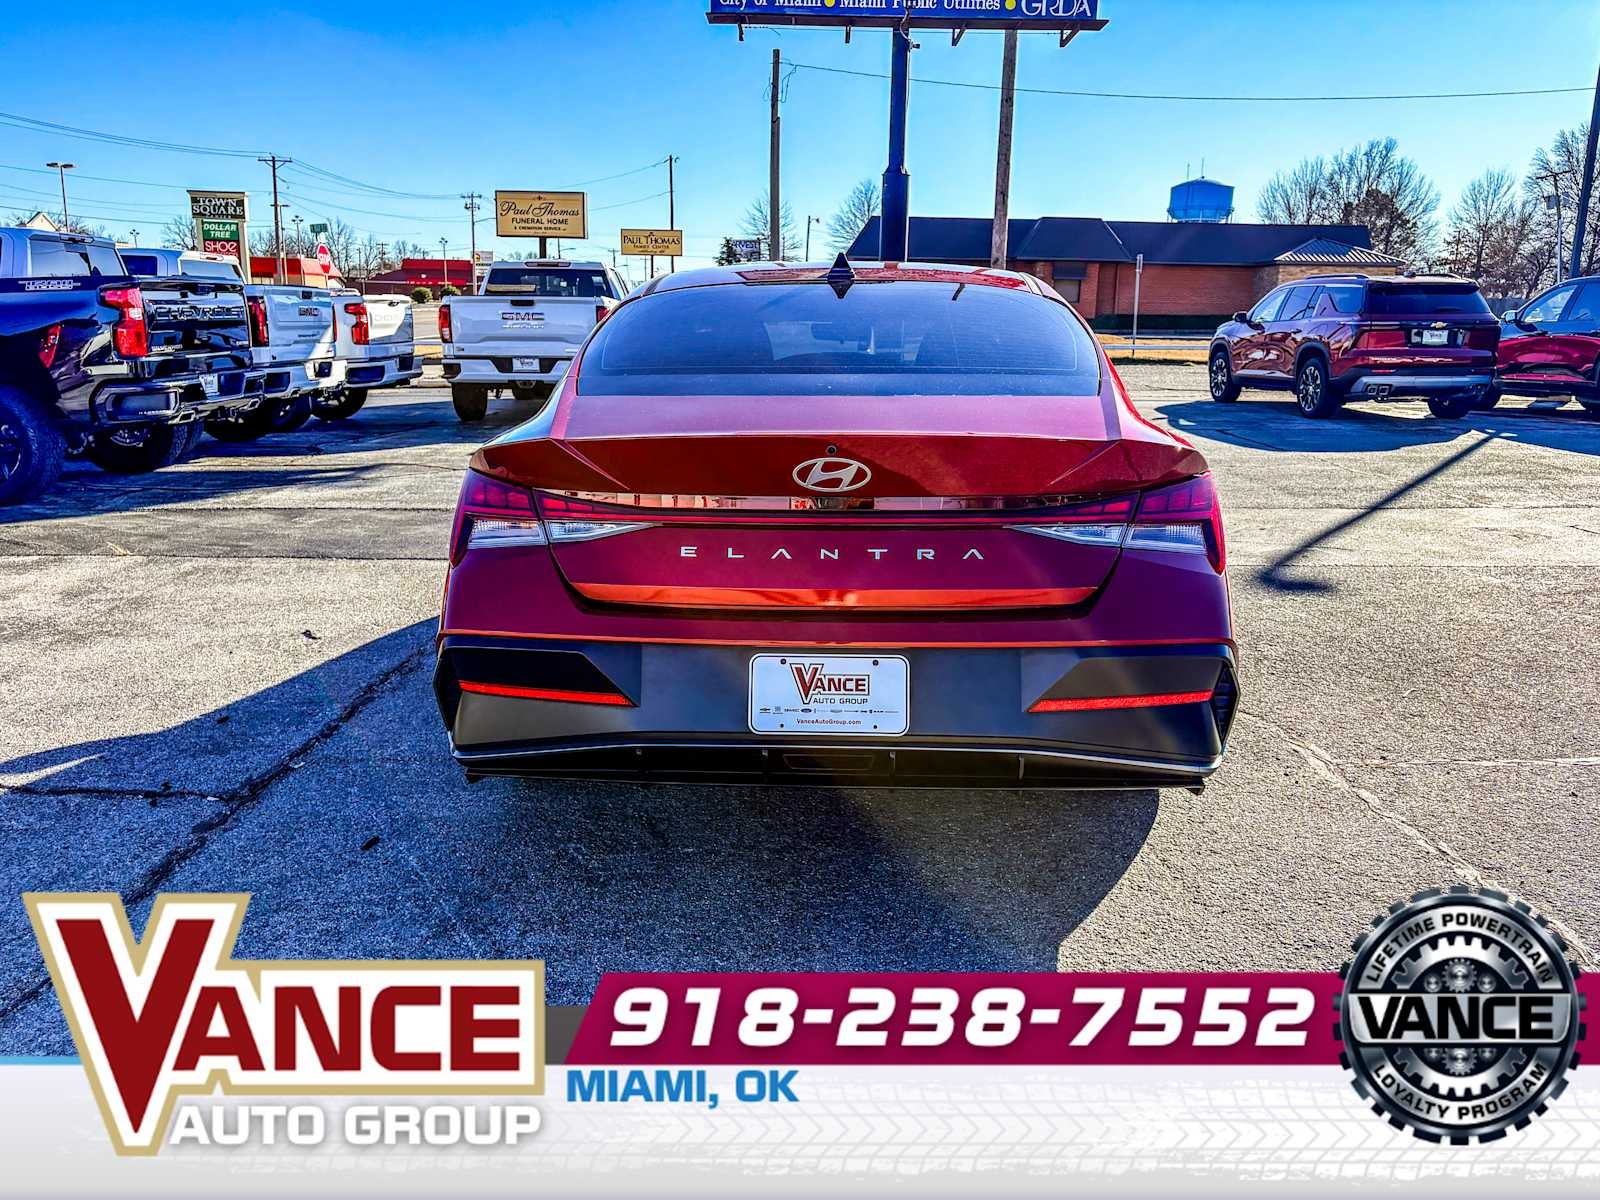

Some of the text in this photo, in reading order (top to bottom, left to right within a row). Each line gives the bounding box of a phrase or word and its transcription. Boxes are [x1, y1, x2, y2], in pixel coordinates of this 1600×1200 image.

[1021, 0, 1092, 16] GRDA
[196, 197, 237, 206] TOWN
[192, 205, 244, 215] SQUARE
[500, 201, 580, 217] Paul Thomas
[511, 217, 544, 225] FUNERAL
[203, 223, 237, 231] DOLLAR
[210, 230, 231, 238] TREE
[623, 235, 681, 245] PAUL THOMAS
[501, 312, 545, 320] GMC
[680, 546, 984, 560] ELANTRA
[791, 665, 867, 702] VANCE
[812, 697, 836, 705] AUTO
[796, 718, 862, 726] VanceAutoGroup.com
